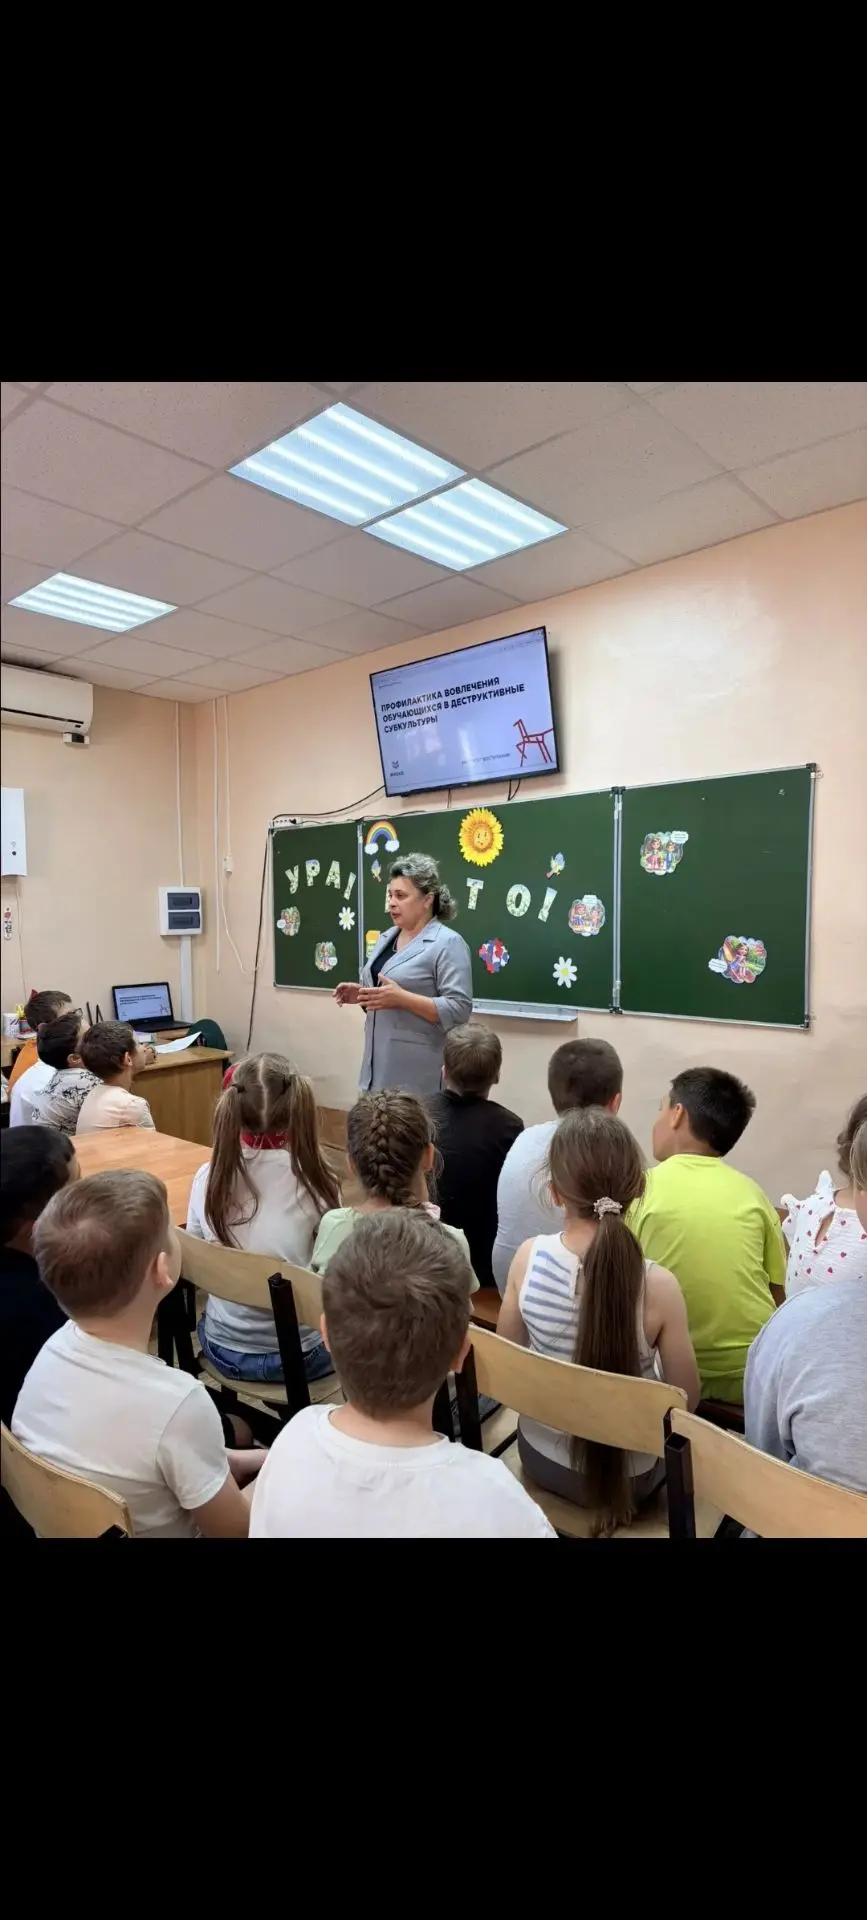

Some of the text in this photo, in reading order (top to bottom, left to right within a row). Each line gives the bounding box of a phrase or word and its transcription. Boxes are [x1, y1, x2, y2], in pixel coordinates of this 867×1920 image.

[381, 677, 500, 712] ПРОФИЛАКТИКА ВОВЛЕЧЕНИЯ
[382, 683, 526, 723] ОБУЧАЮЩИХСЯ В ДЕСТРУКТИВНЫЕ
[384, 715, 438, 733] СУБКУЛЬТУРЫ
[285, 859, 357, 900] УРА!
